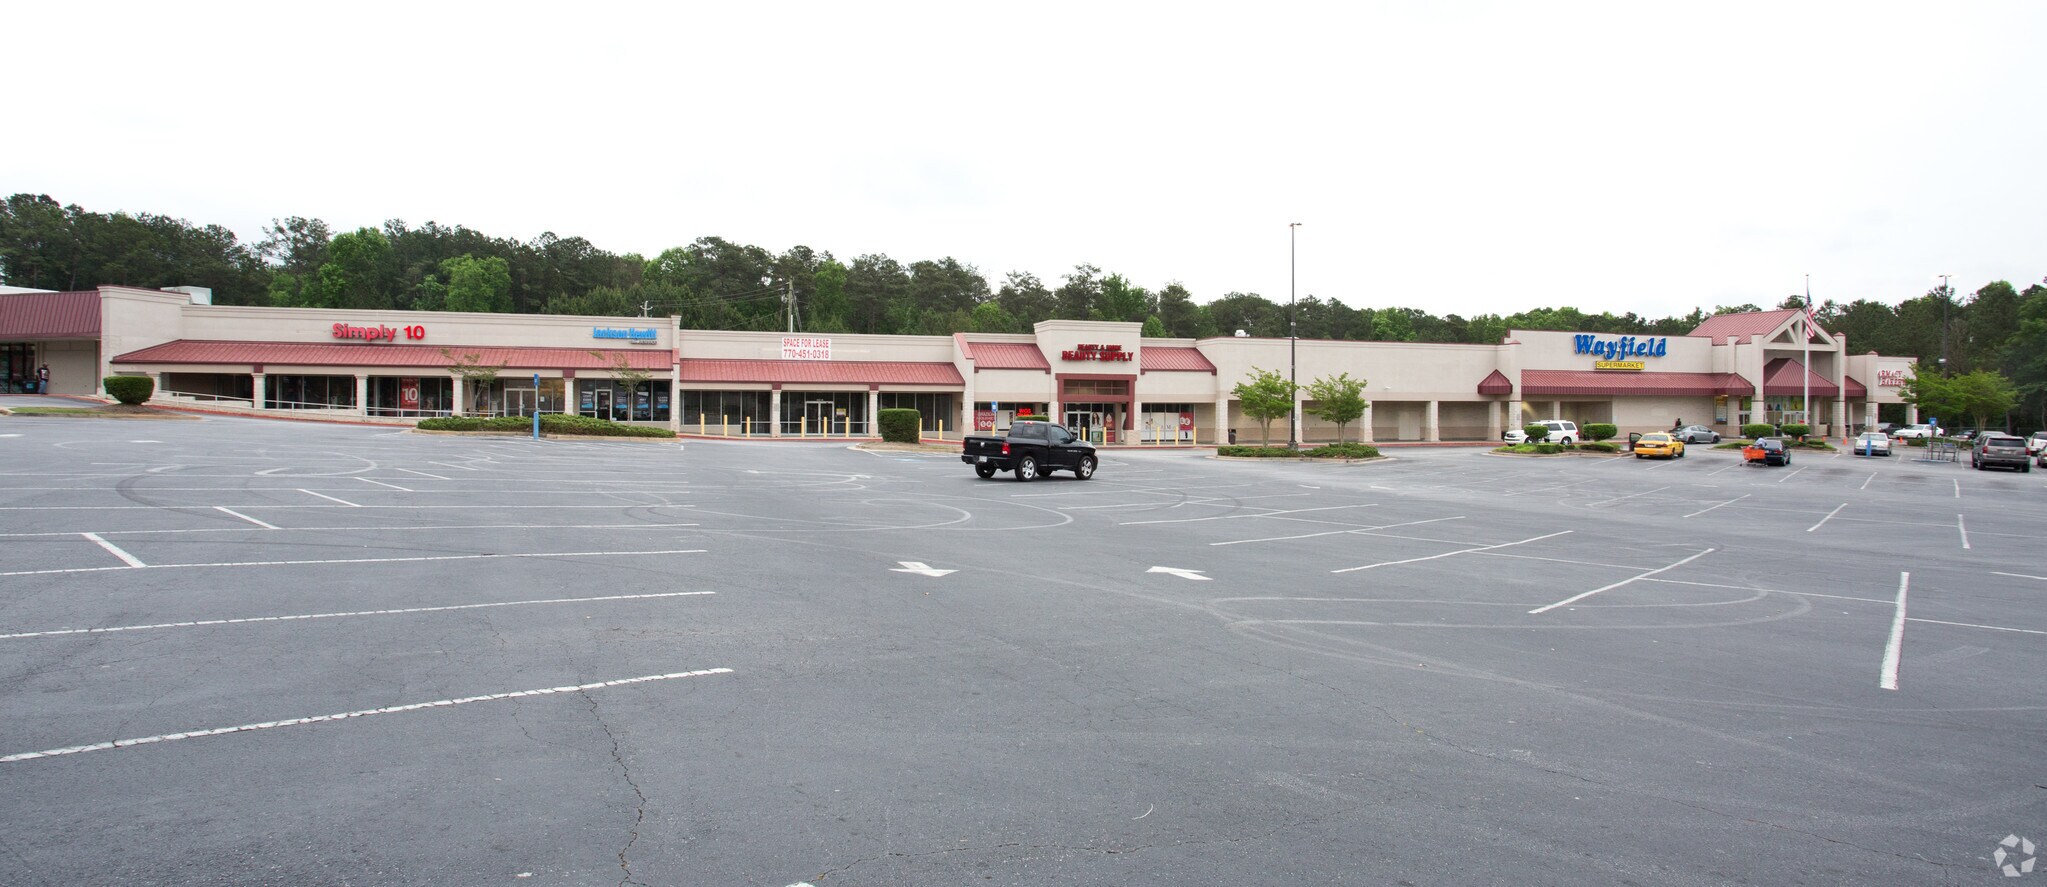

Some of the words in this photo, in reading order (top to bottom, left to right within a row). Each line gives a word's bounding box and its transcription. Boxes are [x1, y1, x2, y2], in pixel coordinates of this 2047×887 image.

[332, 323, 397, 342] Simply
[403, 325, 425, 340] 10
[783, 338, 800, 348] SPACE
[801, 338, 812, 348] FOR
[813, 339, 829, 348] LEASE
[1574, 334, 1667, 361] Wayfield
[783, 349, 830, 359] 770-451-0318
[1061, 350, 1098, 361] BEAUTY
[1099, 351, 1134, 362] SUPPLY
[1597, 361, 1643, 369] SUPERMARKET
[402, 388, 418, 401] 10
